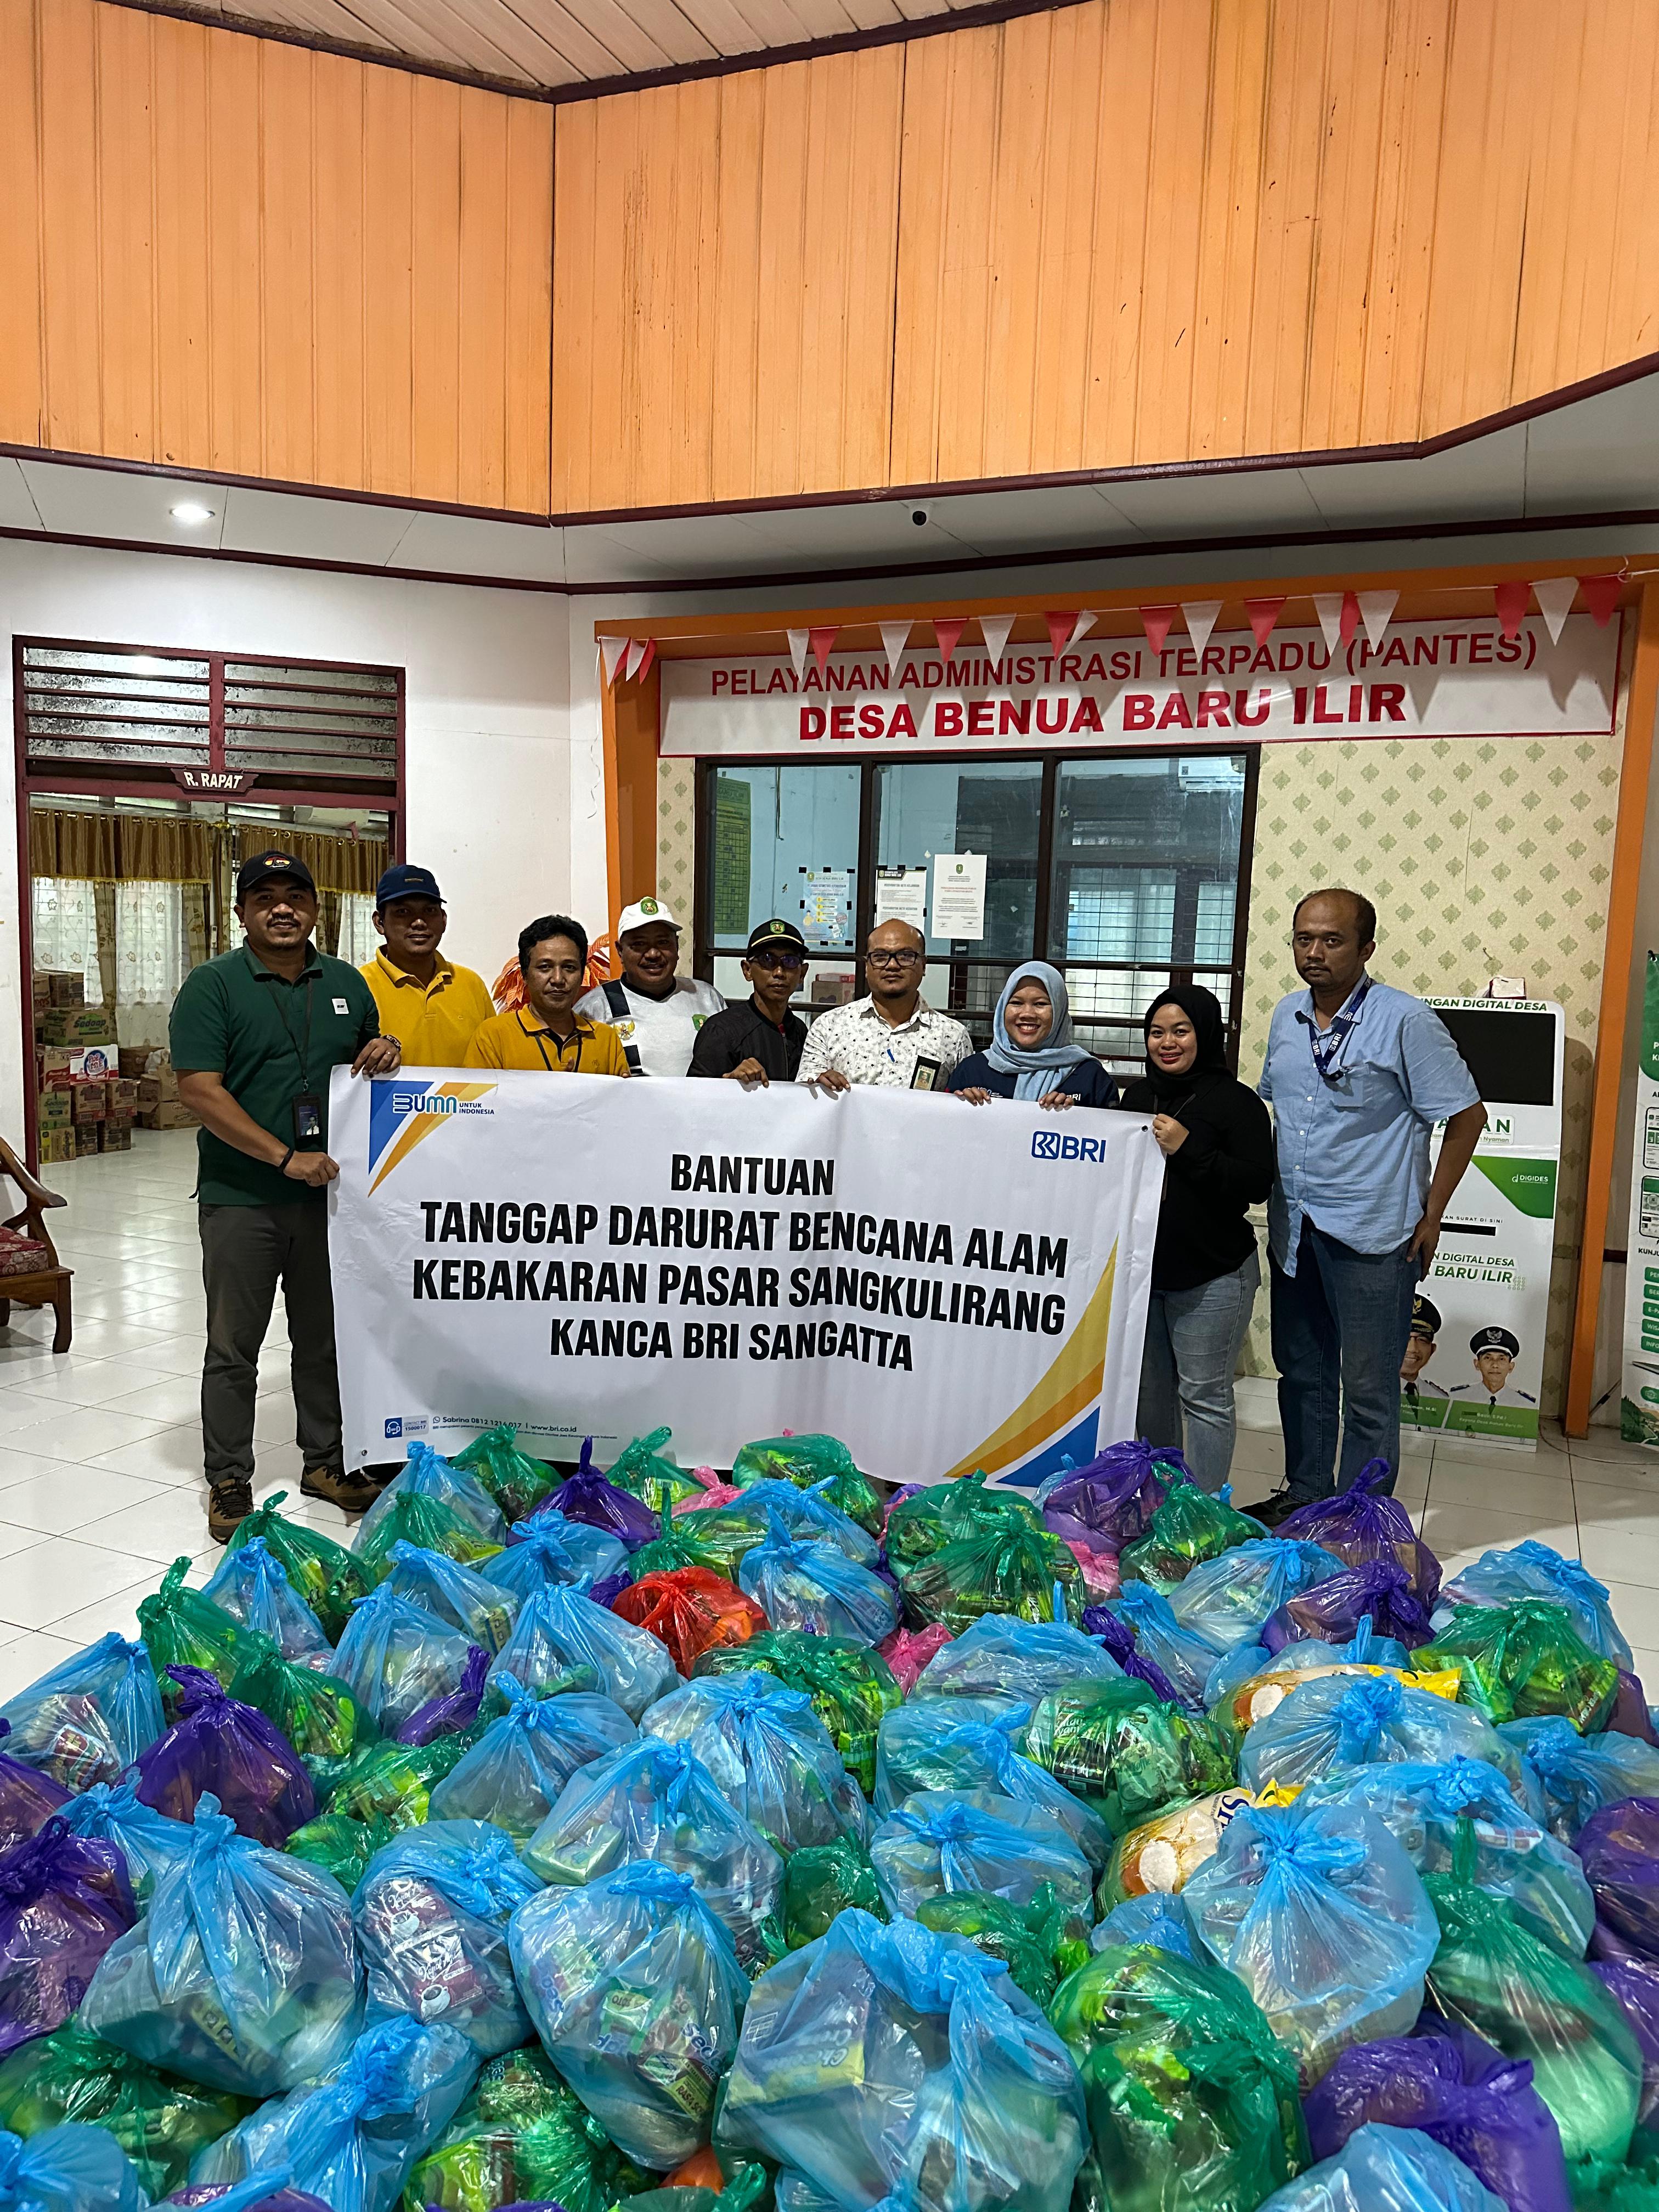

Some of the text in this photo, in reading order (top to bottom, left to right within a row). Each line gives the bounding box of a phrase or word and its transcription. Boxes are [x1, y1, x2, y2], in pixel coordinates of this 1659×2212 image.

[713, 631, 1536, 696] PELAYANAN ADMINISTRASI TERPADU (PANTES)
[799, 684, 1407, 740] DESA BENUA BARU ILIR
[183, 771, 244, 789] R. RAPAT
[1421, 998, 1548, 1011] NGAN DIGITAL DESA
[1331, 1033, 1342, 1046] BRI
[1061, 1136, 1107, 1163] BRI
[671, 1154, 834, 1196] BANTUAN
[420, 1201, 1068, 1278] TANGGAP DARURAT BENCANA ALAM
[1442, 1253, 1485, 1264] DIGITAL
[1486, 1257, 1515, 1267] DESA
[1434, 1265, 1513, 1283] BARU ILIR
[413, 1259, 1066, 1335] KEBAKARAN PASAR SANGKULIRANG
[550, 1318, 913, 1372] KANCA BRI SANGATTA
[675, 2085, 695, 2107] RASA
